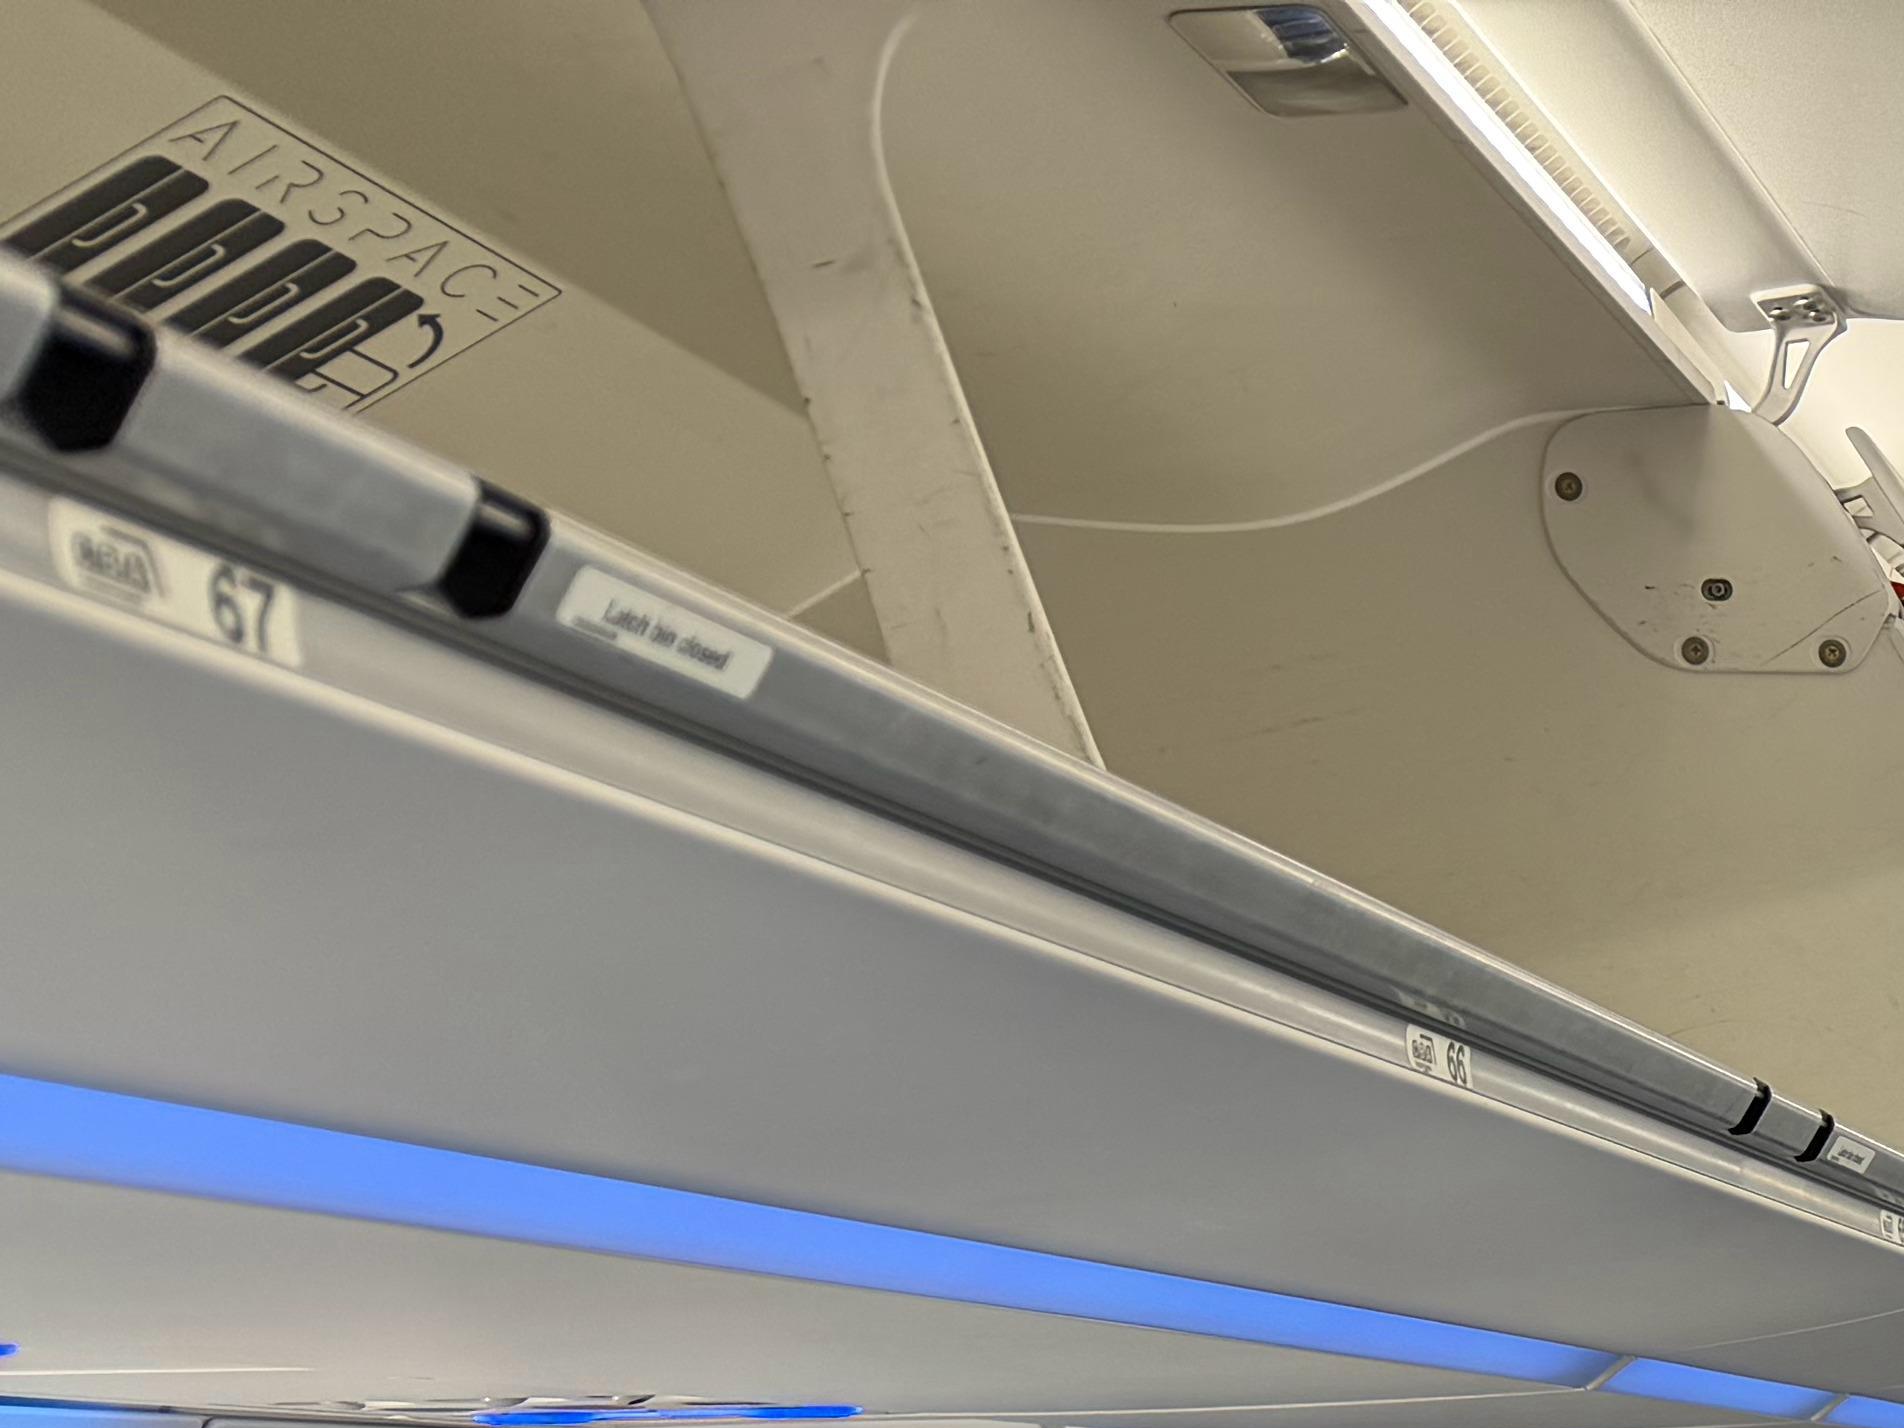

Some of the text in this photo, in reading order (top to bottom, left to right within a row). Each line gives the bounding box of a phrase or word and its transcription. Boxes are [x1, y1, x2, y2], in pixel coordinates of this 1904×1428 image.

[168, 119, 541, 323] AIRSPACE
[208, 561, 275, 652] 67
[603, 598, 651, 637] Latch
[675, 634, 733, 672] closed
[1447, 1041, 1467, 1085] 66
